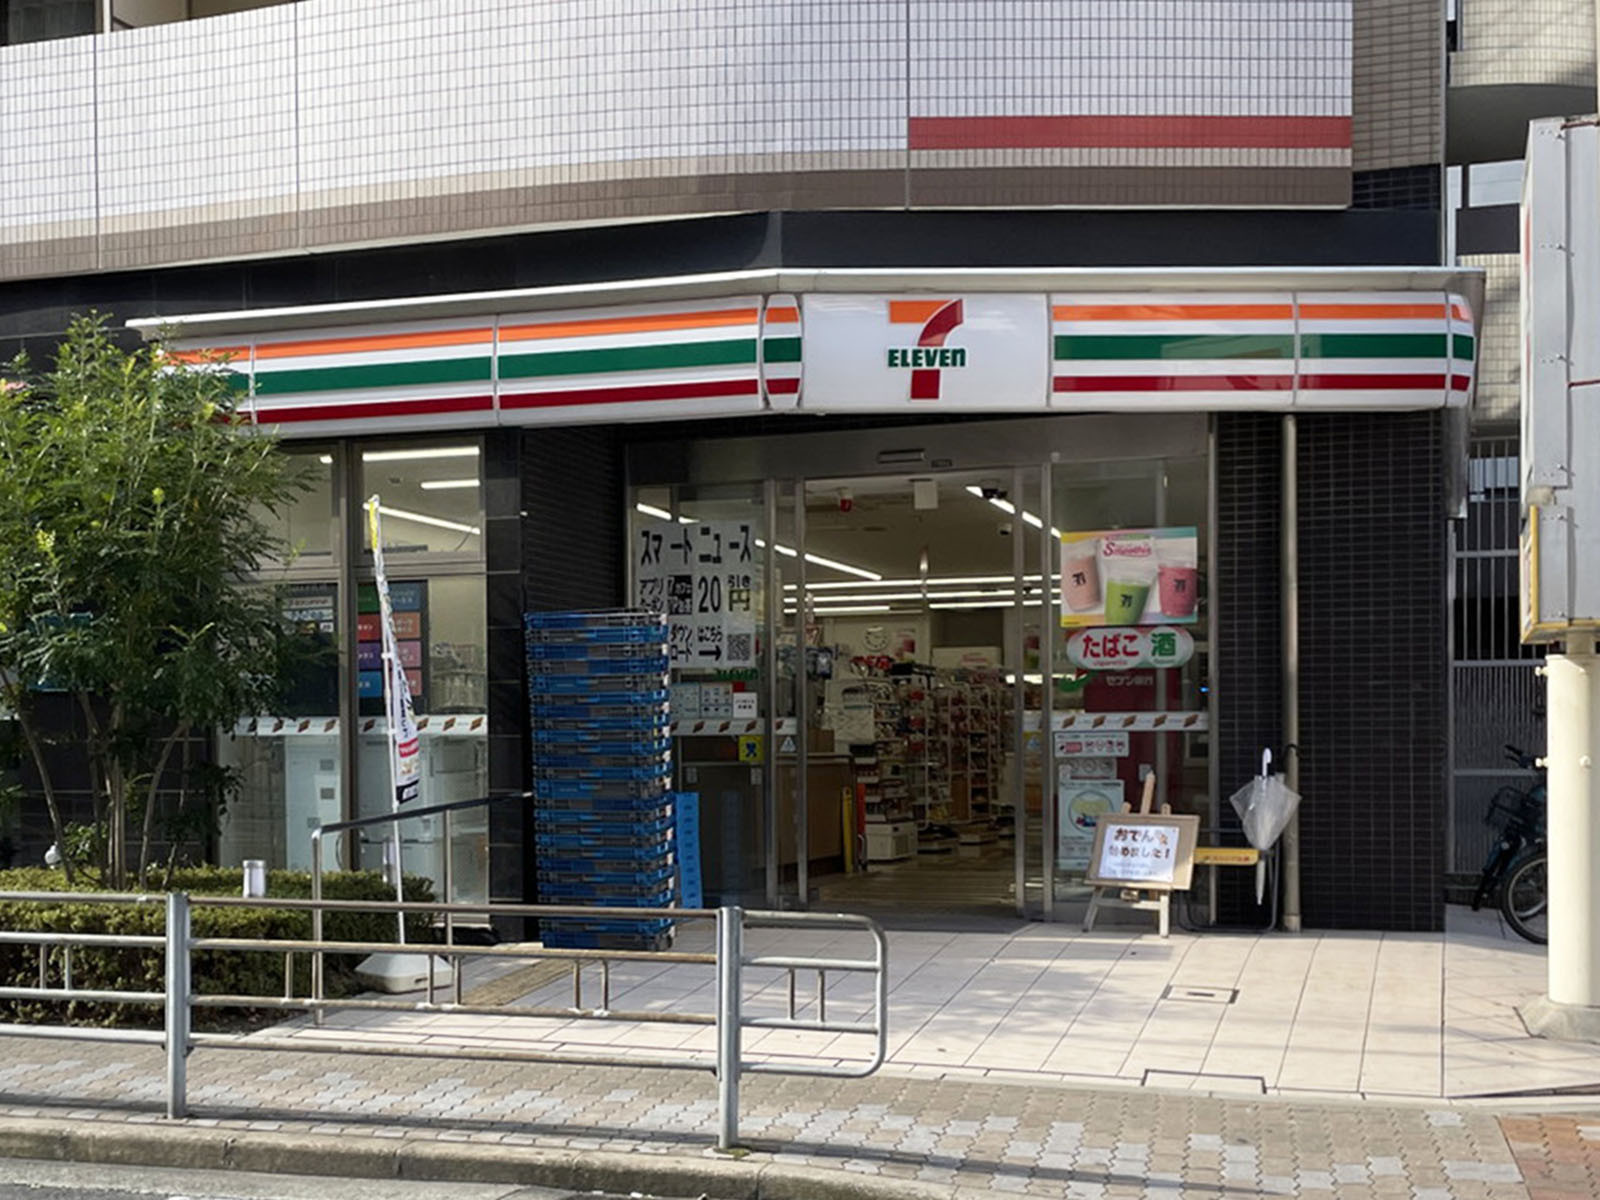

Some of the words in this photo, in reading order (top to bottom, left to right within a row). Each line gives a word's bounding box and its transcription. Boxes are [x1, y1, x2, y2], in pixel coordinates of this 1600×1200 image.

[641, 525, 752, 566] スマートニュース
[698, 575, 721, 613] 20
[729, 588, 751, 612] 円
[1082, 633, 1140, 659] たばこ
[1151, 633, 1176, 657] 酒
[1114, 827, 1154, 841] おでん
